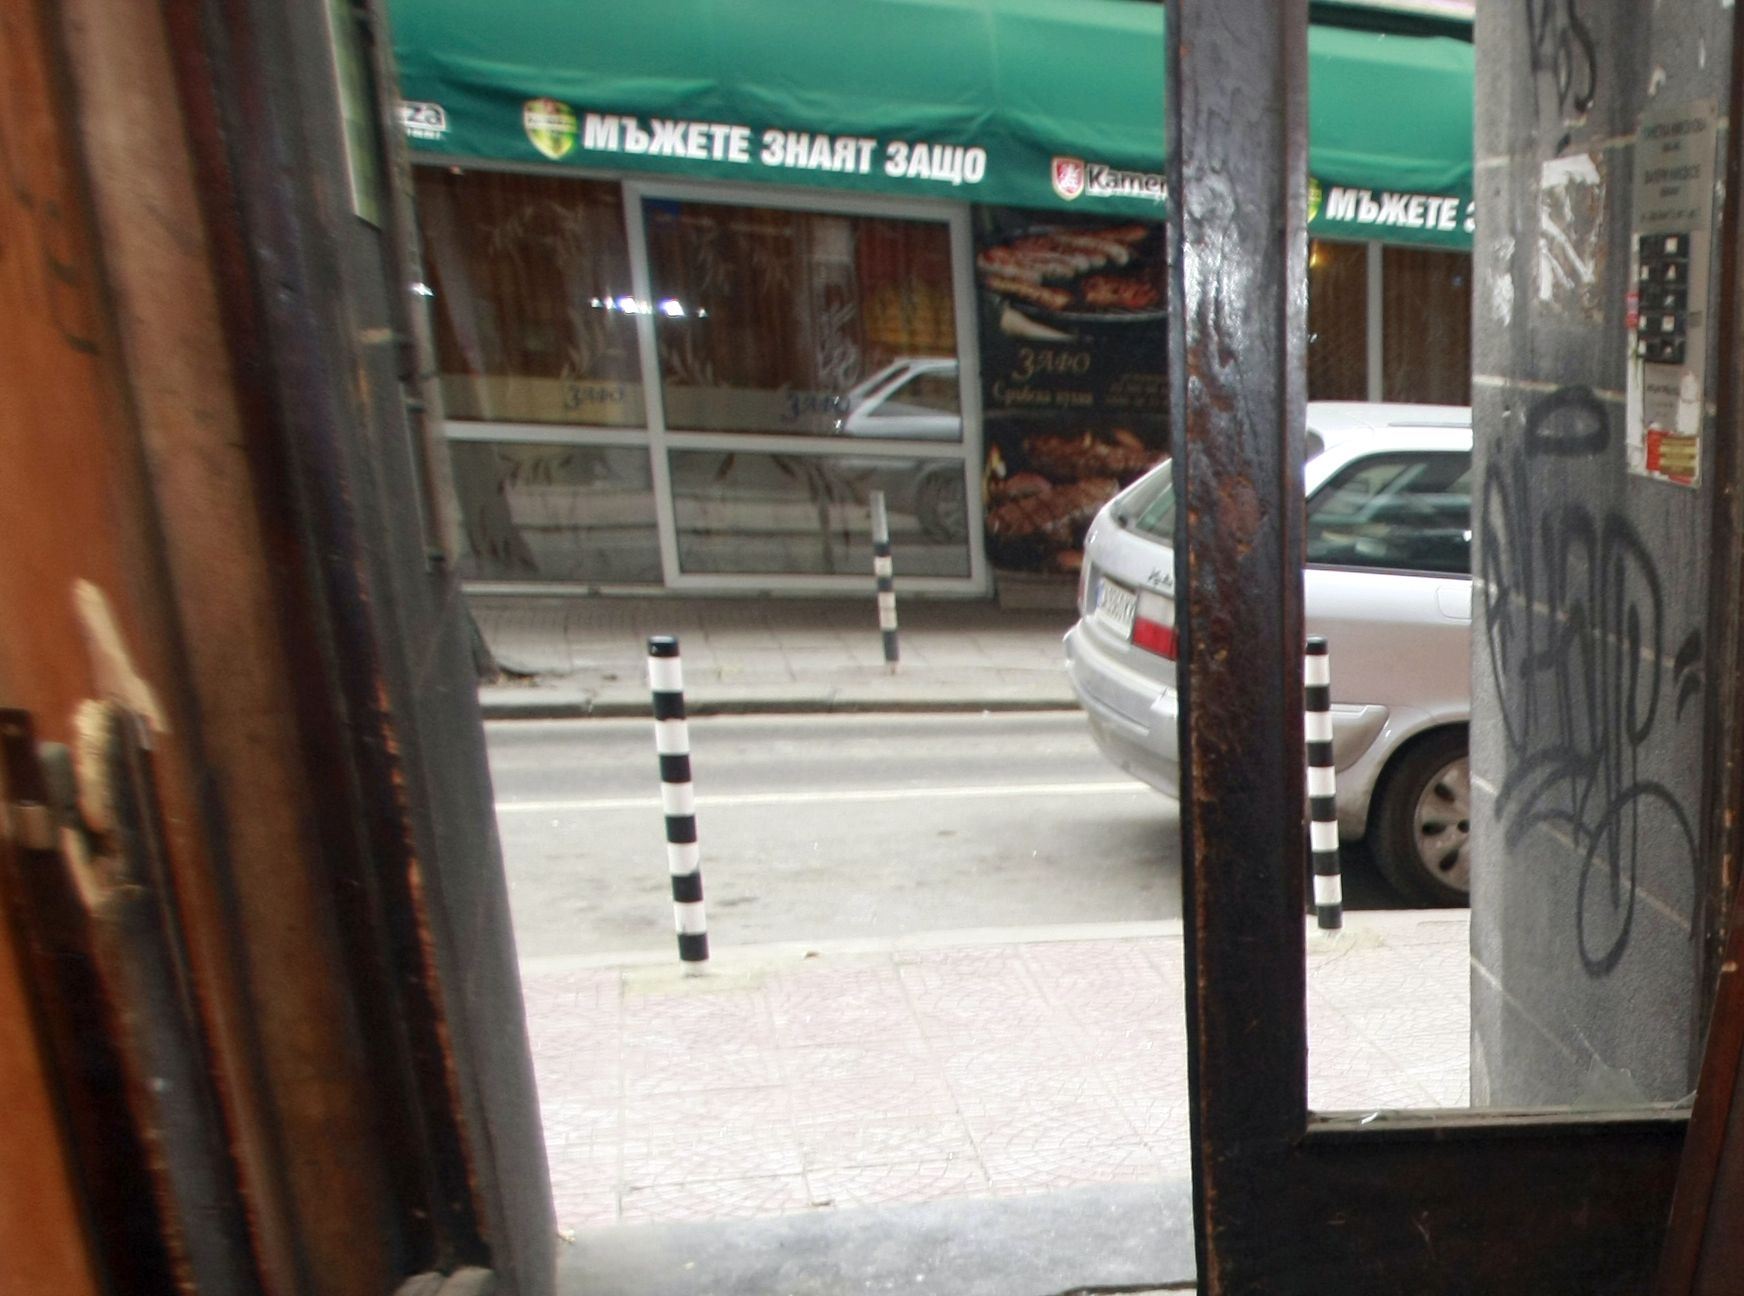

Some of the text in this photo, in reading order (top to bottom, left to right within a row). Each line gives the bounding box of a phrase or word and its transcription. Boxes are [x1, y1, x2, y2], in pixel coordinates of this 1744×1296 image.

[583, 112, 988, 186] МЪЖЕТЕ ЗНАЯТ ЗАЩО
[1324, 186, 1460, 232] МЪЖЕТЕ
